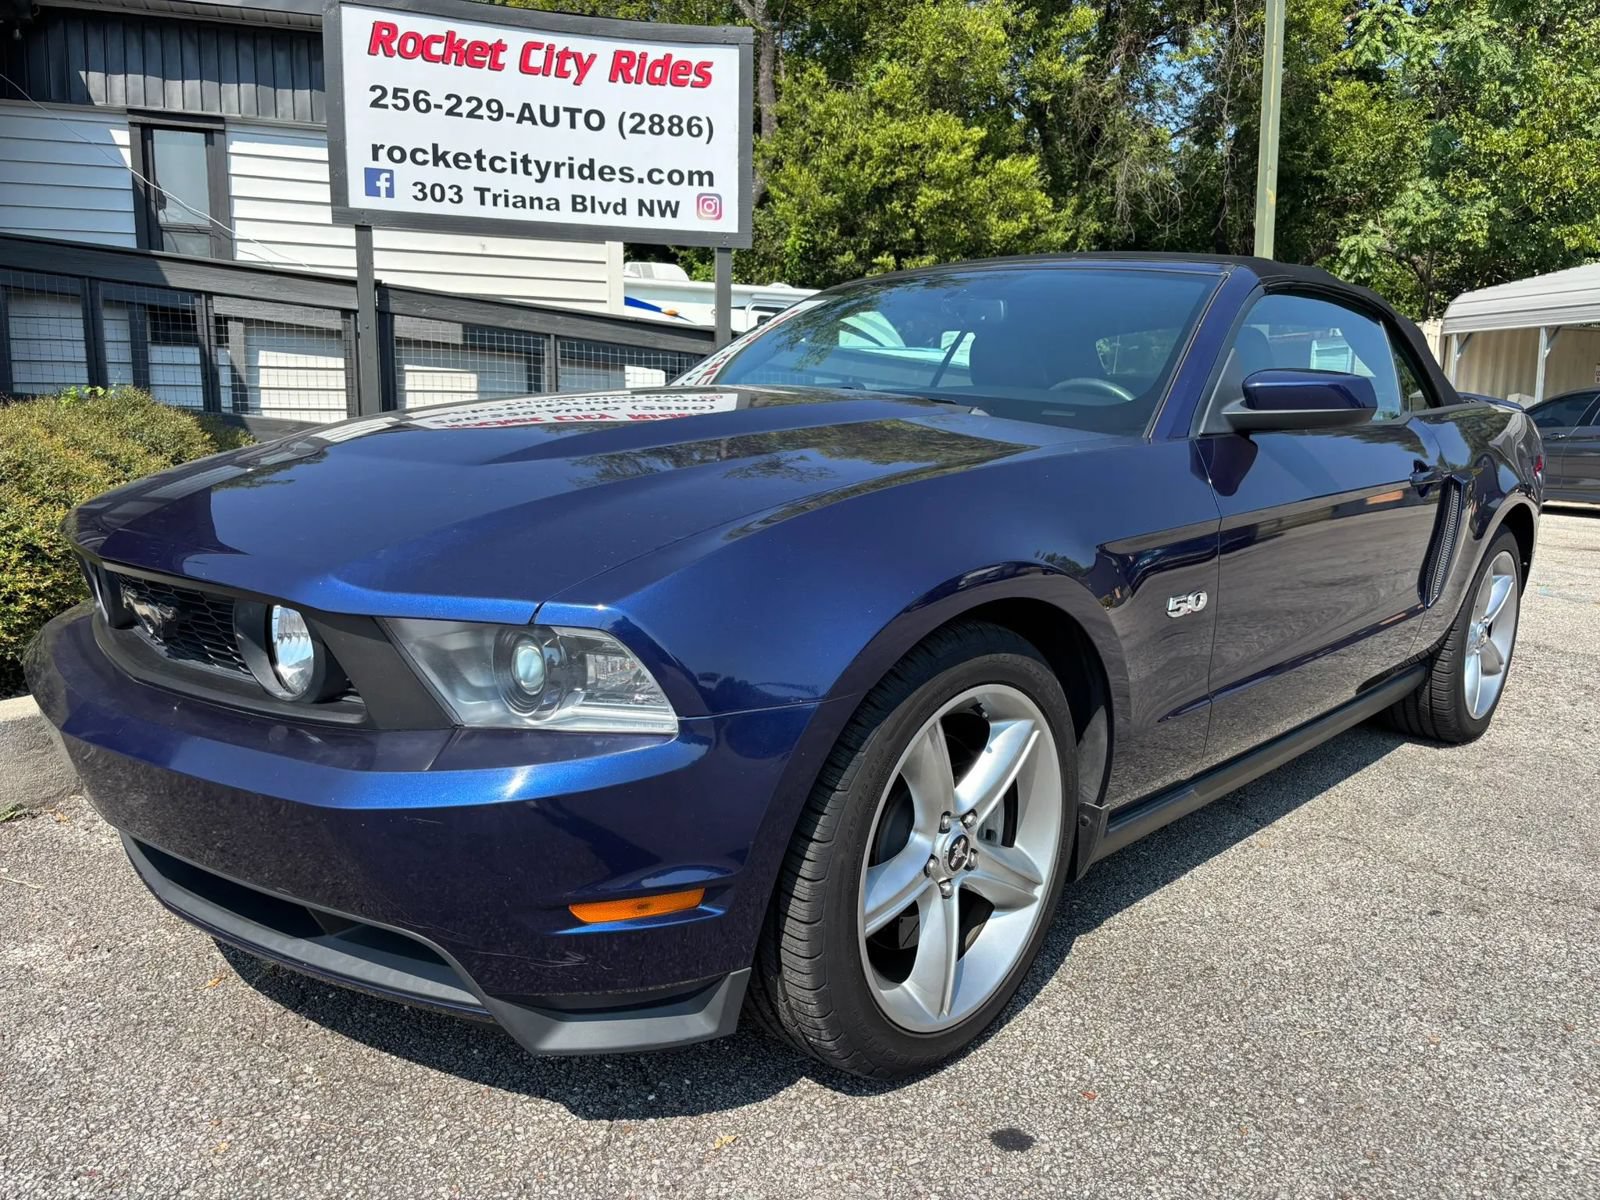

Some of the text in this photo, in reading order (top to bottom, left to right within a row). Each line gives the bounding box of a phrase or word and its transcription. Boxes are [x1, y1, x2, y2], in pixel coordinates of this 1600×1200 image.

[368, 21, 714, 88] Rocket City Rides
[369, 84, 714, 144] 256-229-AUTO (2886)
[371, 142, 715, 187] rocketcityrides.com
[412, 181, 680, 219] 303 Triana Blvd NW
